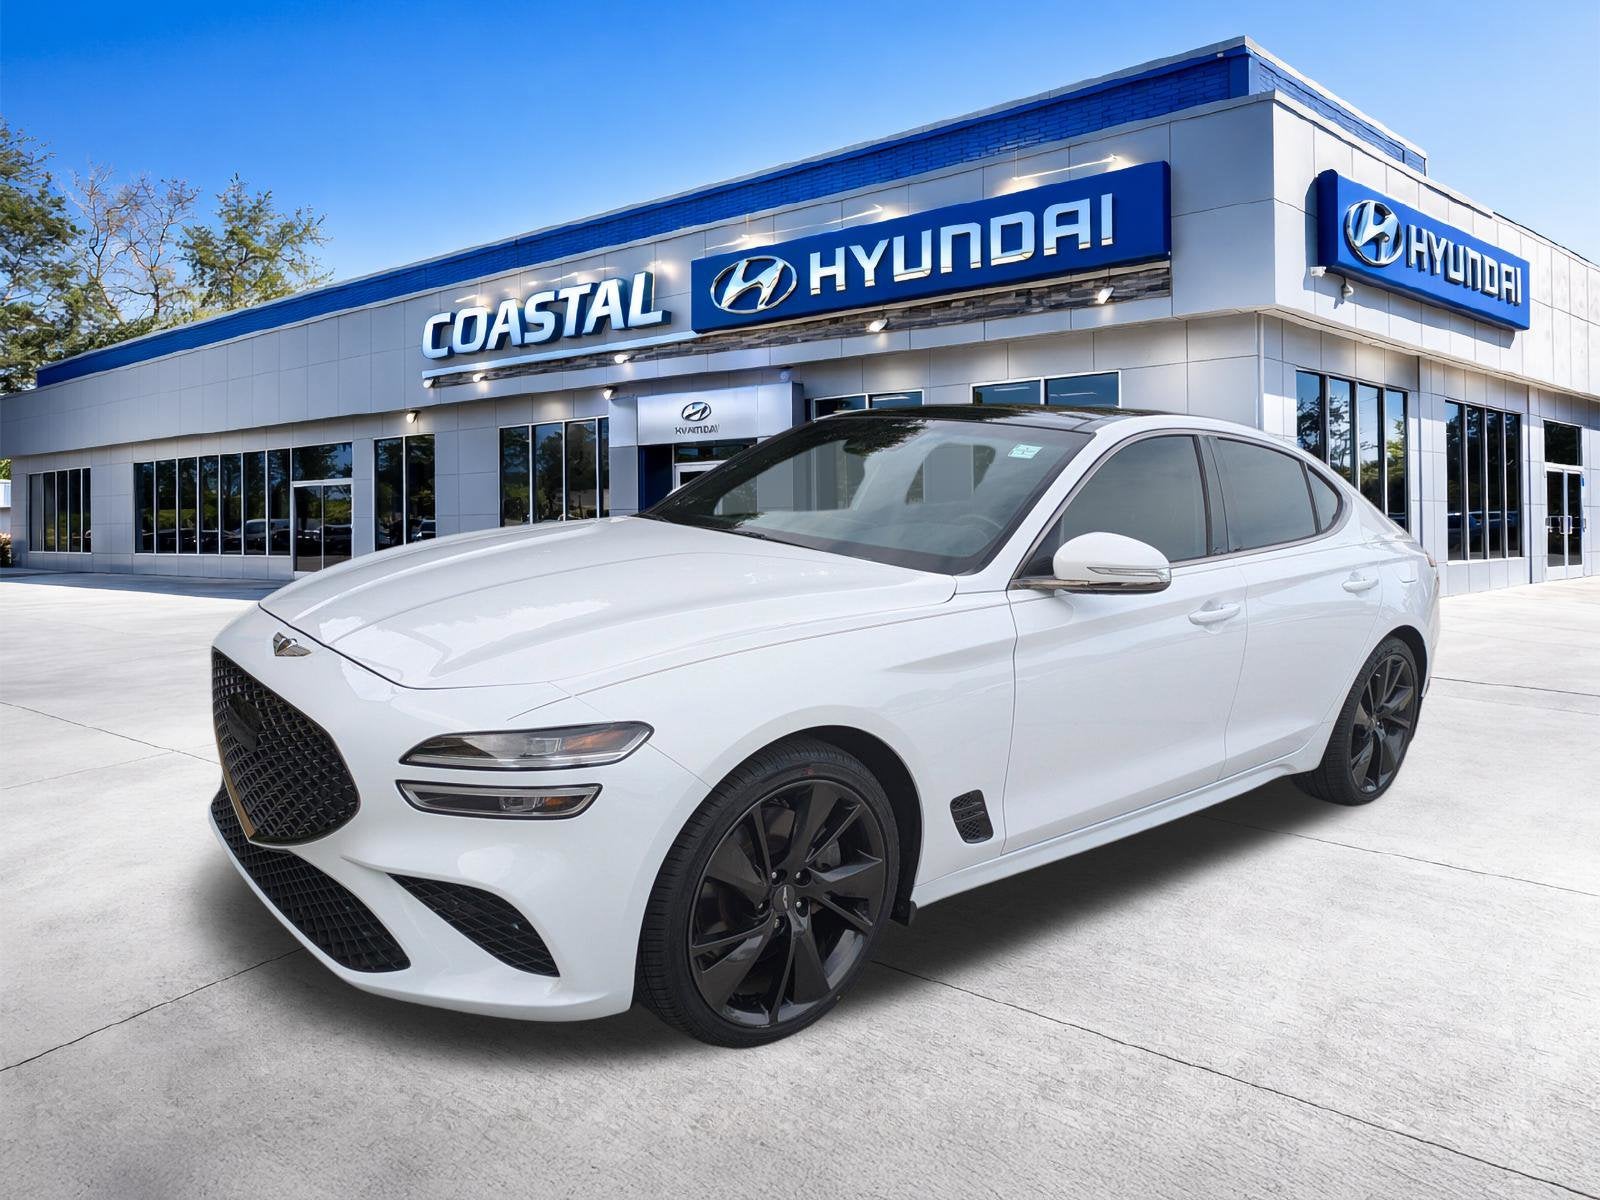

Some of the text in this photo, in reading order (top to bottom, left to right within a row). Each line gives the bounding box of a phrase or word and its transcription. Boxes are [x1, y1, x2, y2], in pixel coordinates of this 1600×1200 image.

[810, 193, 1113, 295] HYUNDAI
[1406, 224, 1522, 305] HYUNDAI
[422, 271, 669, 359] COASTAL
